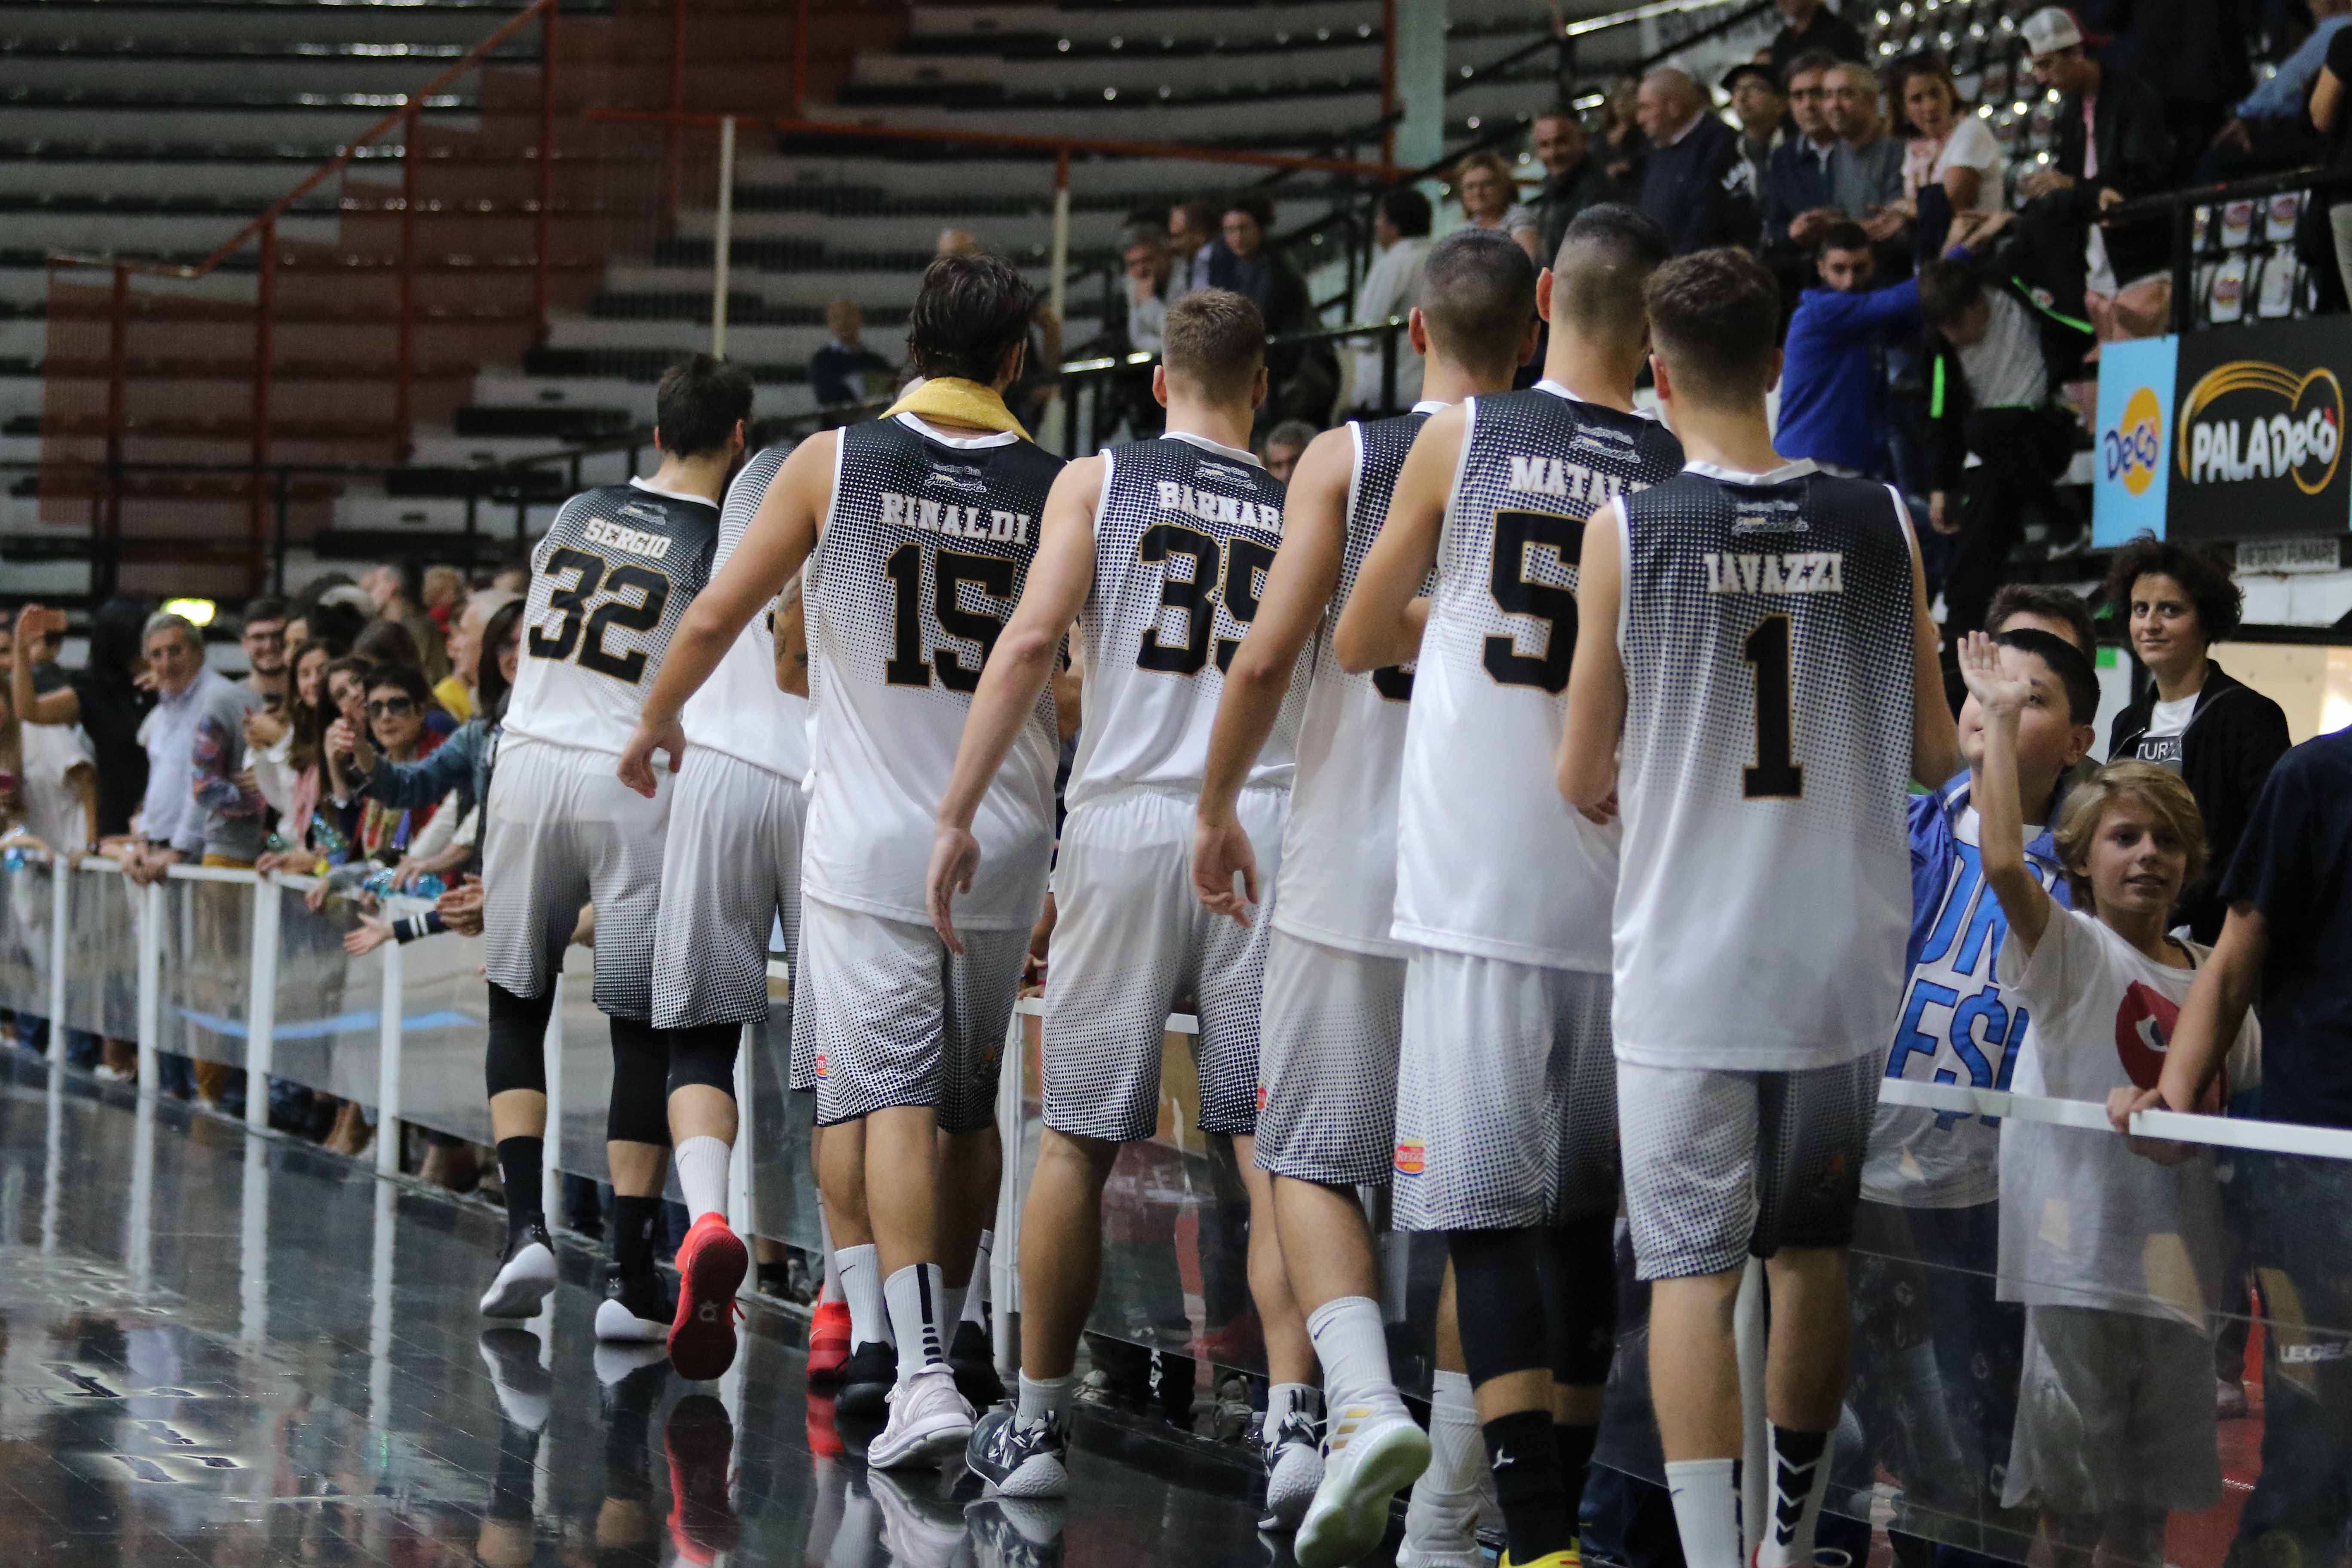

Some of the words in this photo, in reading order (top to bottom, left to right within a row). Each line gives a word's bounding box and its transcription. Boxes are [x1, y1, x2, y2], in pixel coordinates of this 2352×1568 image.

[584, 517, 672, 559] SERGIO
[880, 492, 1032, 545] RINALDI
[1157, 481, 1285, 537] BARNAB
[1509, 456, 1652, 506] MATAL
[529, 545, 673, 685] 32
[885, 540, 1018, 693] 15
[1136, 522, 1280, 680] 35
[1481, 508, 1589, 696] 5
[1742, 612, 1804, 800] 1
